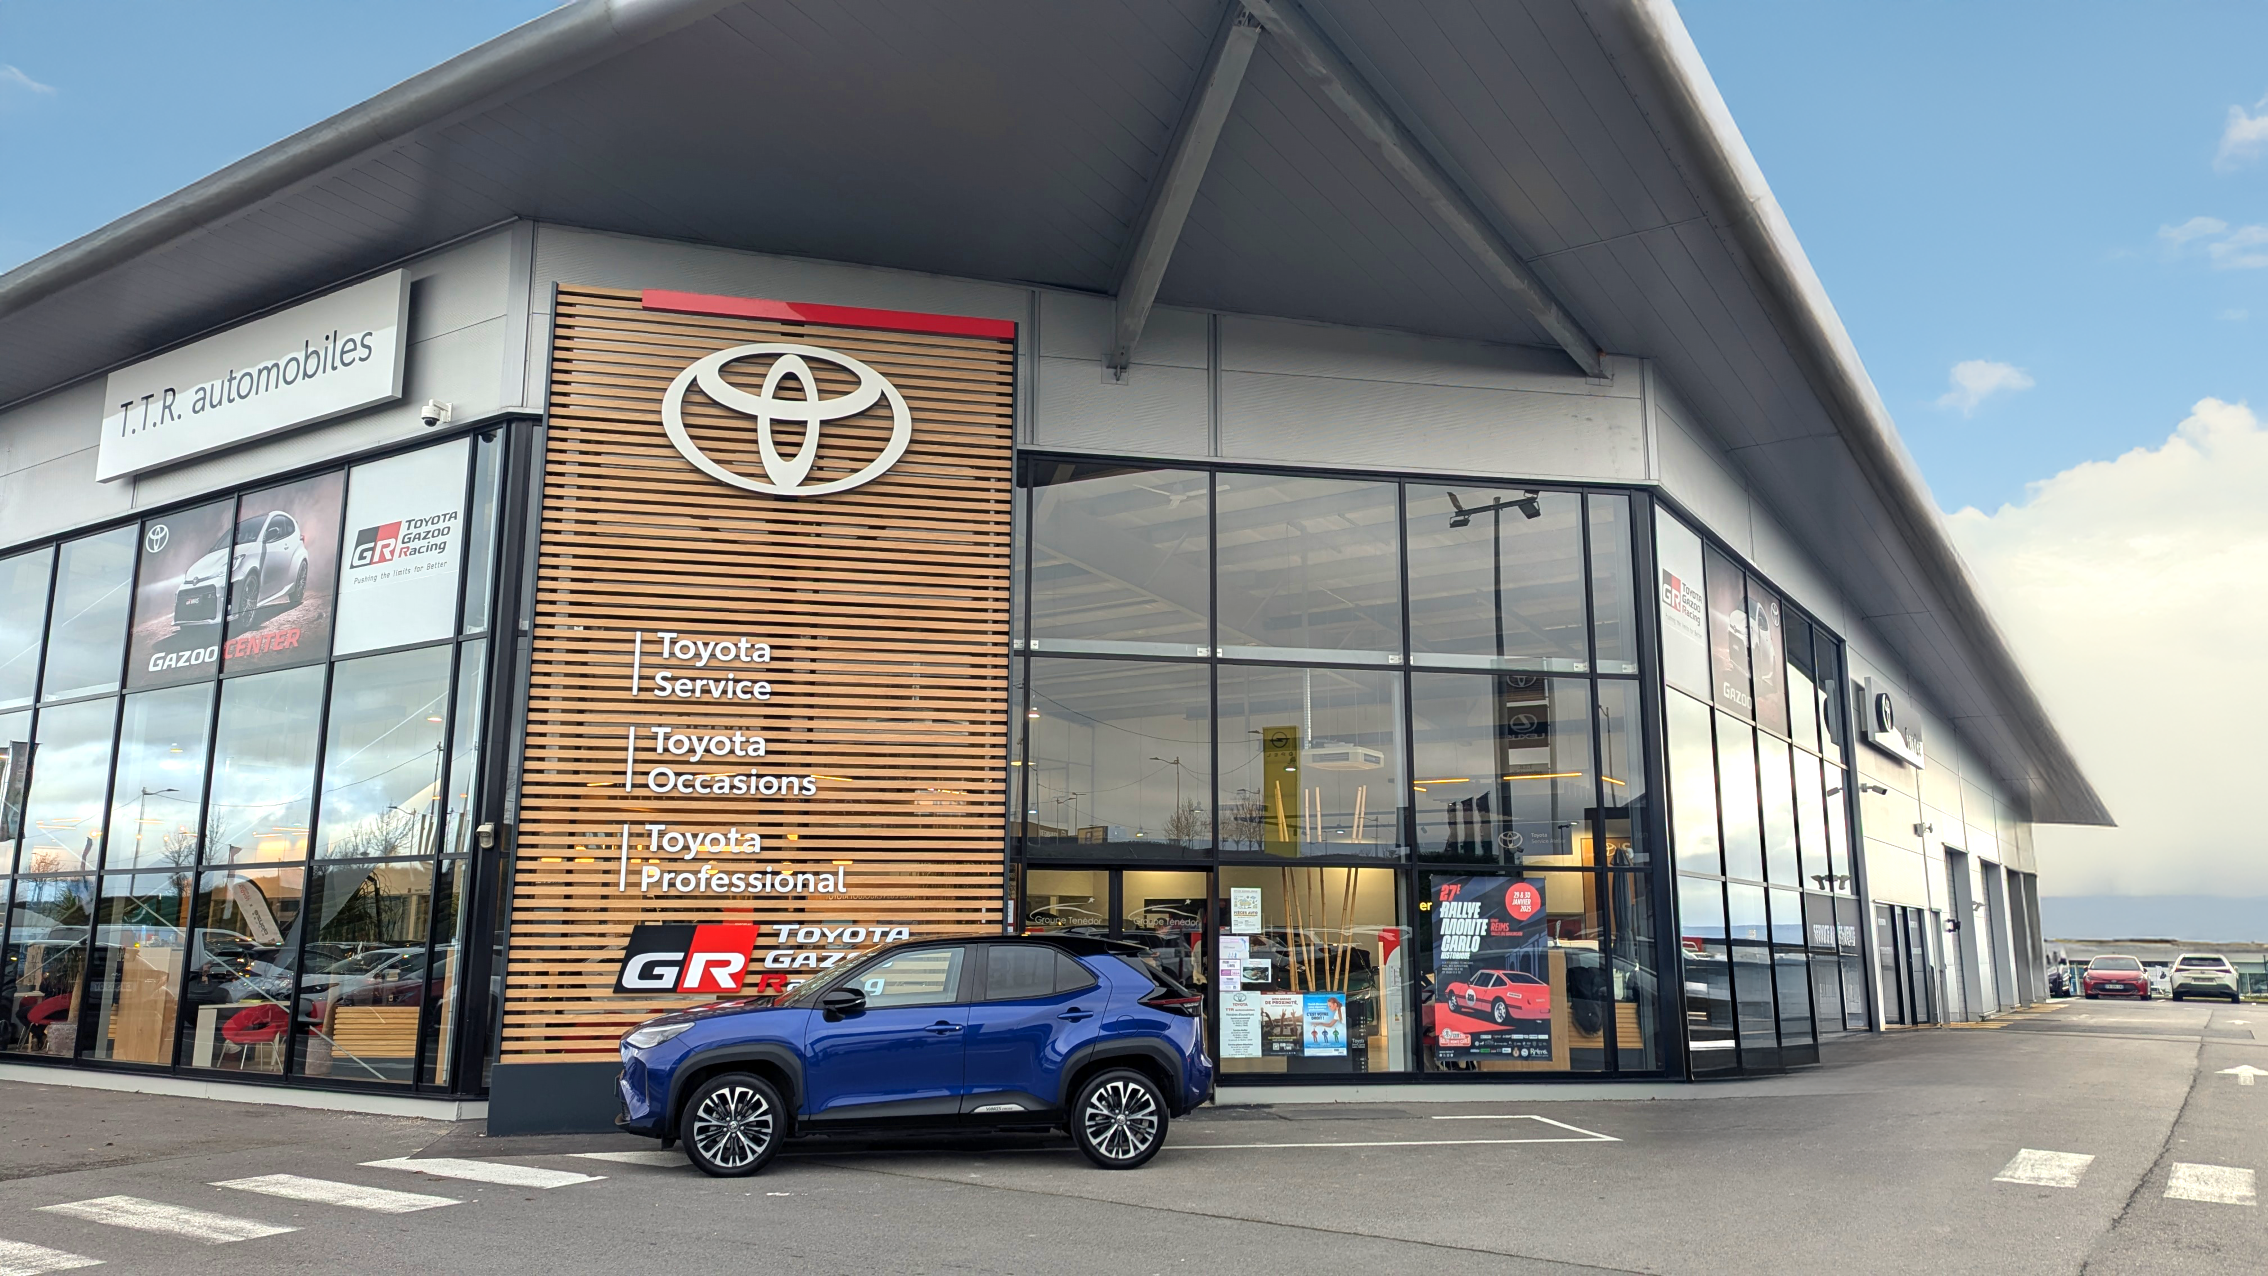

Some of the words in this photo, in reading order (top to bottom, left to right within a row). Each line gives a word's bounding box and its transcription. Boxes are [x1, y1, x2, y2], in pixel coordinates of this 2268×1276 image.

[120, 387, 182, 438] T.T.R.
[191, 329, 374, 415] automobiles
[405, 511, 458, 531] TOYOTA
[401, 526, 451, 545] GAZOO
[351, 537, 396, 567] GR
[398, 540, 447, 558] Racing
[353, 575, 378, 585] Pushing
[380, 571, 391, 579] the
[393, 567, 411, 577] limits
[413, 565, 424, 573] for
[426, 561, 448, 571] Better
[1662, 583, 1681, 611] GR
[1682, 582, 1703, 604] TOYOTA
[1682, 595, 1701, 614] GAZOO
[1681, 605, 1701, 627] Racing
[148, 645, 219, 672] GAZOO
[223, 628, 301, 660] CENTER
[656, 631, 772, 667] Toyota
[653, 671, 773, 701] Service
[650, 726, 767, 762] Toyota
[647, 767, 818, 796] Occasions
[645, 824, 762, 860] Toyota
[640, 864, 848, 894] Professional
[1512, 898, 1532, 906] JANVIER
[1513, 891, 1519, 899] 29
[1524, 891, 1531, 899] 30
[1439, 902, 1482, 919] RALLYE
[1519, 905, 1532, 913] 2025
[1034, 915, 1067, 926] Groupe
[1133, 916, 1165, 927] Groupe
[1440, 918, 1489, 936] MONTE
[1490, 922, 1510, 932] REIMS
[772, 924, 911, 944] TOYOTA
[1440, 935, 1481, 953] CARLO
[763, 949, 893, 969] GAZ
[621, 951, 746, 990] GR
